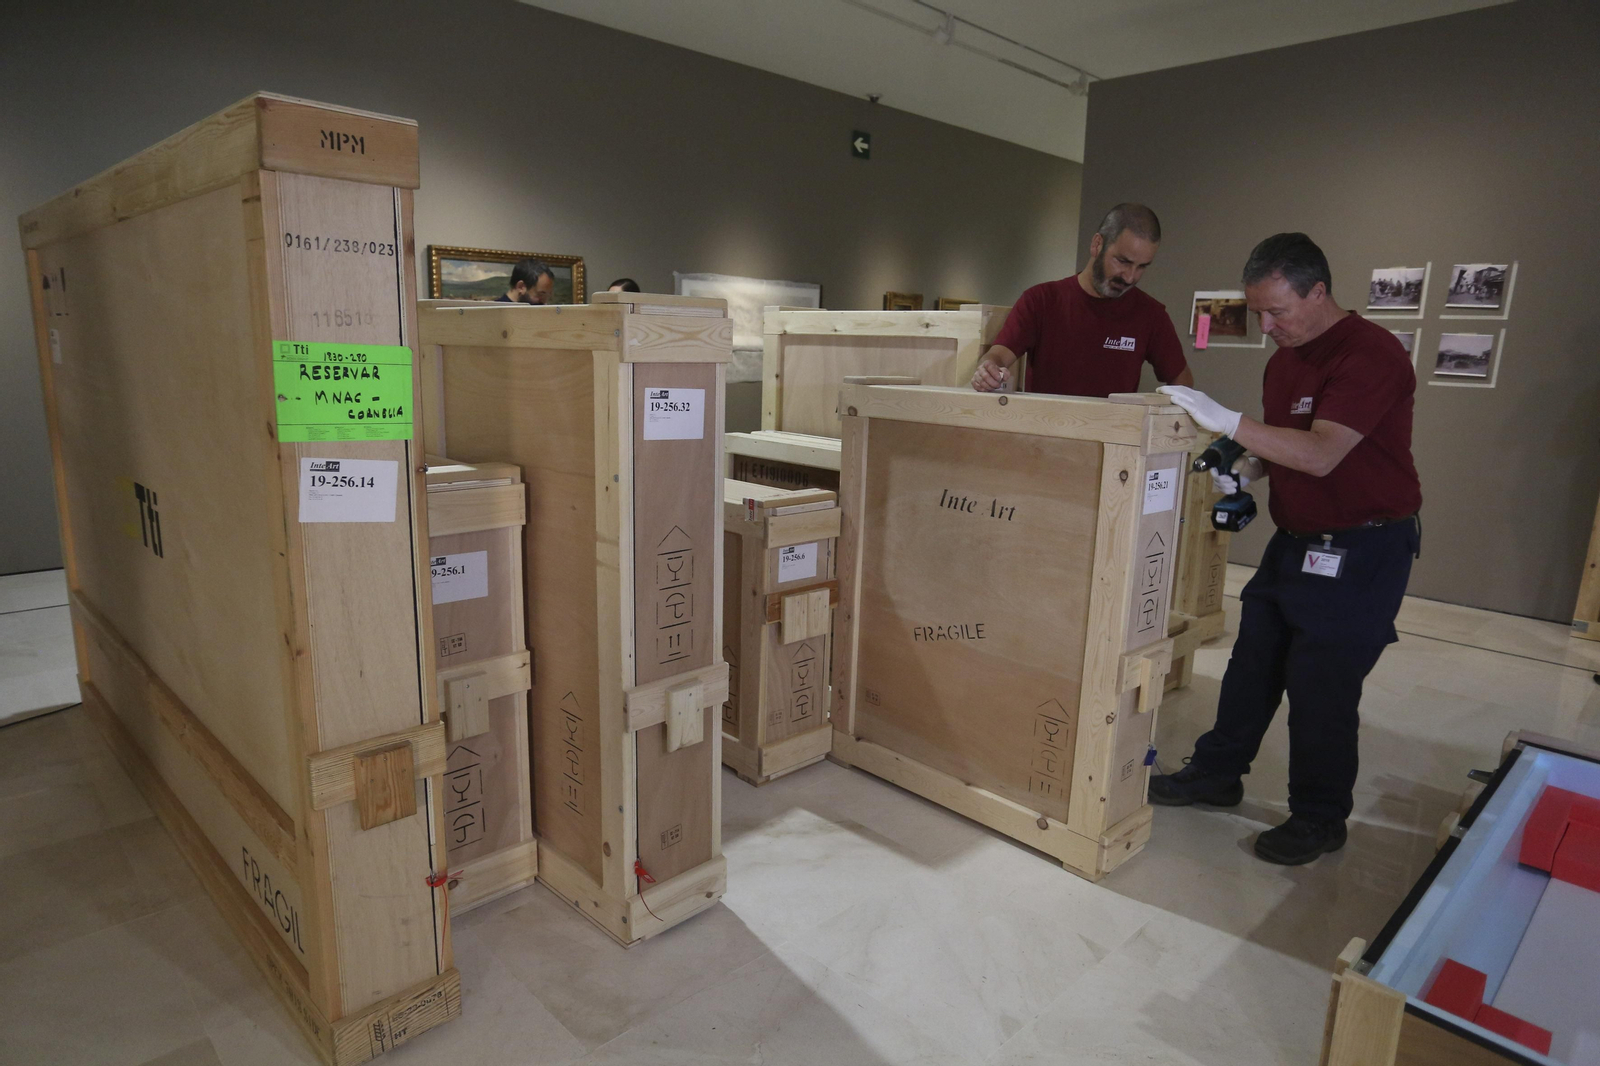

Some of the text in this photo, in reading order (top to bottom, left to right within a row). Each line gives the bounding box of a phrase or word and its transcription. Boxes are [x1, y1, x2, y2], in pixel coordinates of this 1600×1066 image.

[321, 130, 365, 154] MPM
[285, 233, 394, 256] 0161/238/023
[293, 344, 309, 354] Tti
[300, 364, 380, 380] RESERVAR
[315, 390, 361, 405] MNAC
[650, 402, 690, 412] 19-256.32
[310, 475, 374, 488] 19-256.14
[939, 488, 1016, 522] Inte Art
[134, 482, 163, 559] Tti
[782, 553, 805, 563] 19-256.6
[431, 565, 465, 577] 9-256.1
[914, 623, 986, 641] FRAGILE
[242, 846, 305, 954] FRAGIL
